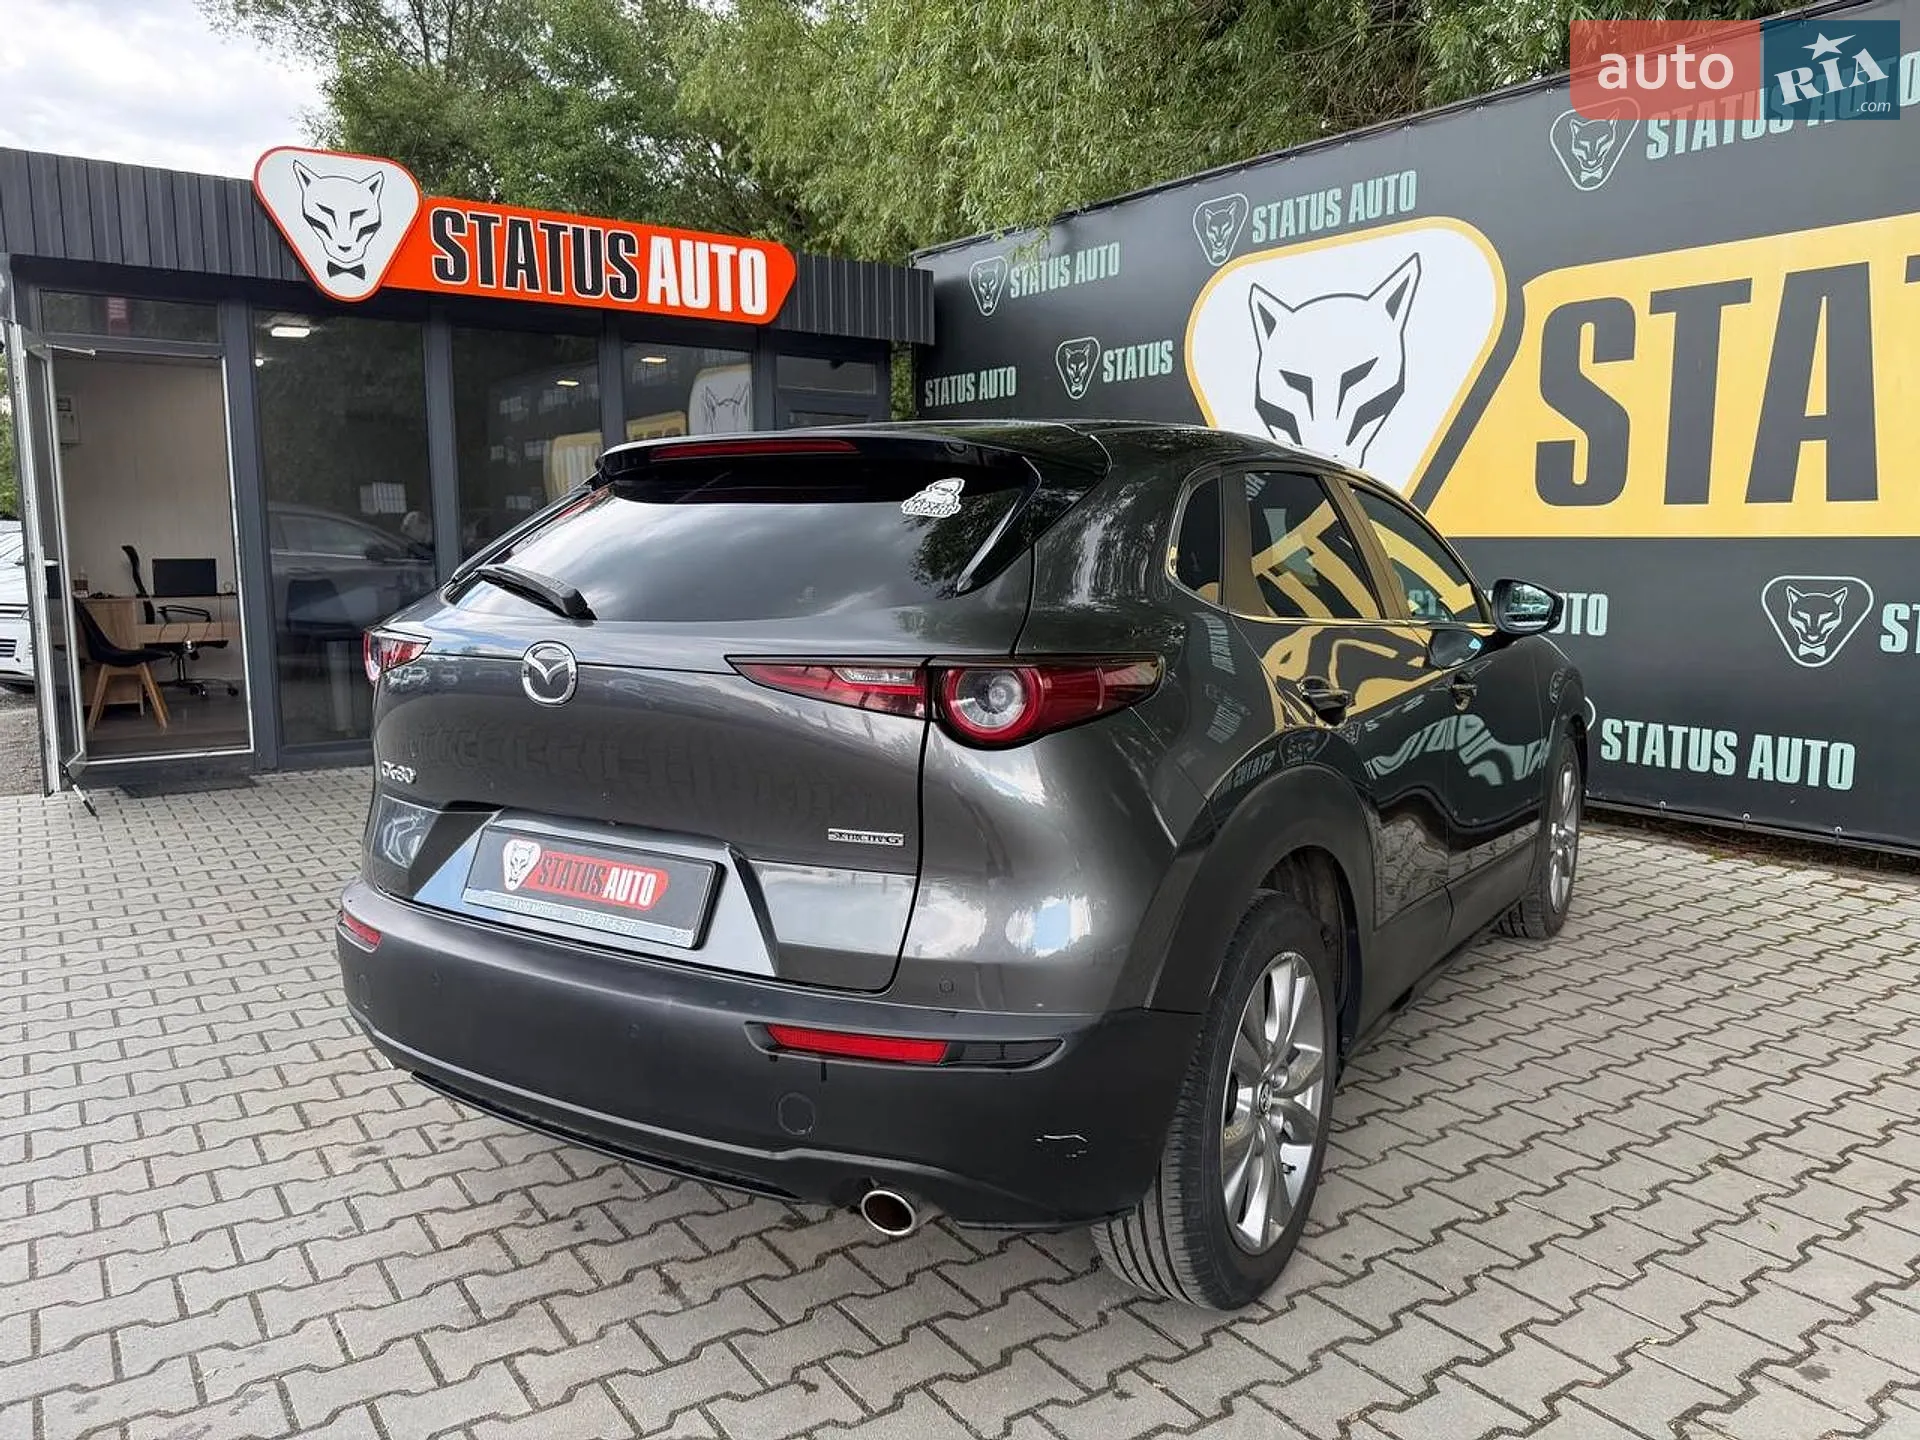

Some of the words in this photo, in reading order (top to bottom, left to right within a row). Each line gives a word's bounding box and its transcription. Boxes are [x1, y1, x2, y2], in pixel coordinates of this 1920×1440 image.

[1252, 187, 1342, 244] STATUS
[1349, 169, 1418, 224] AUTO
[429, 206, 640, 303] STATUS
[647, 234, 768, 317] AUTO
[1010, 253, 1071, 299] STATUS
[1074, 241, 1121, 285] AUTO
[925, 372, 976, 408] STATUS
[978, 365, 1017, 399] AUTO
[1102, 339, 1174, 383] STATUS
[1535, 254, 1920, 507] STA
[1600, 718, 1738, 776] STATUS
[1747, 734, 1856, 791] AUTO
[538, 853, 608, 898] STATUS
[600, 866, 657, 908] AUTO
